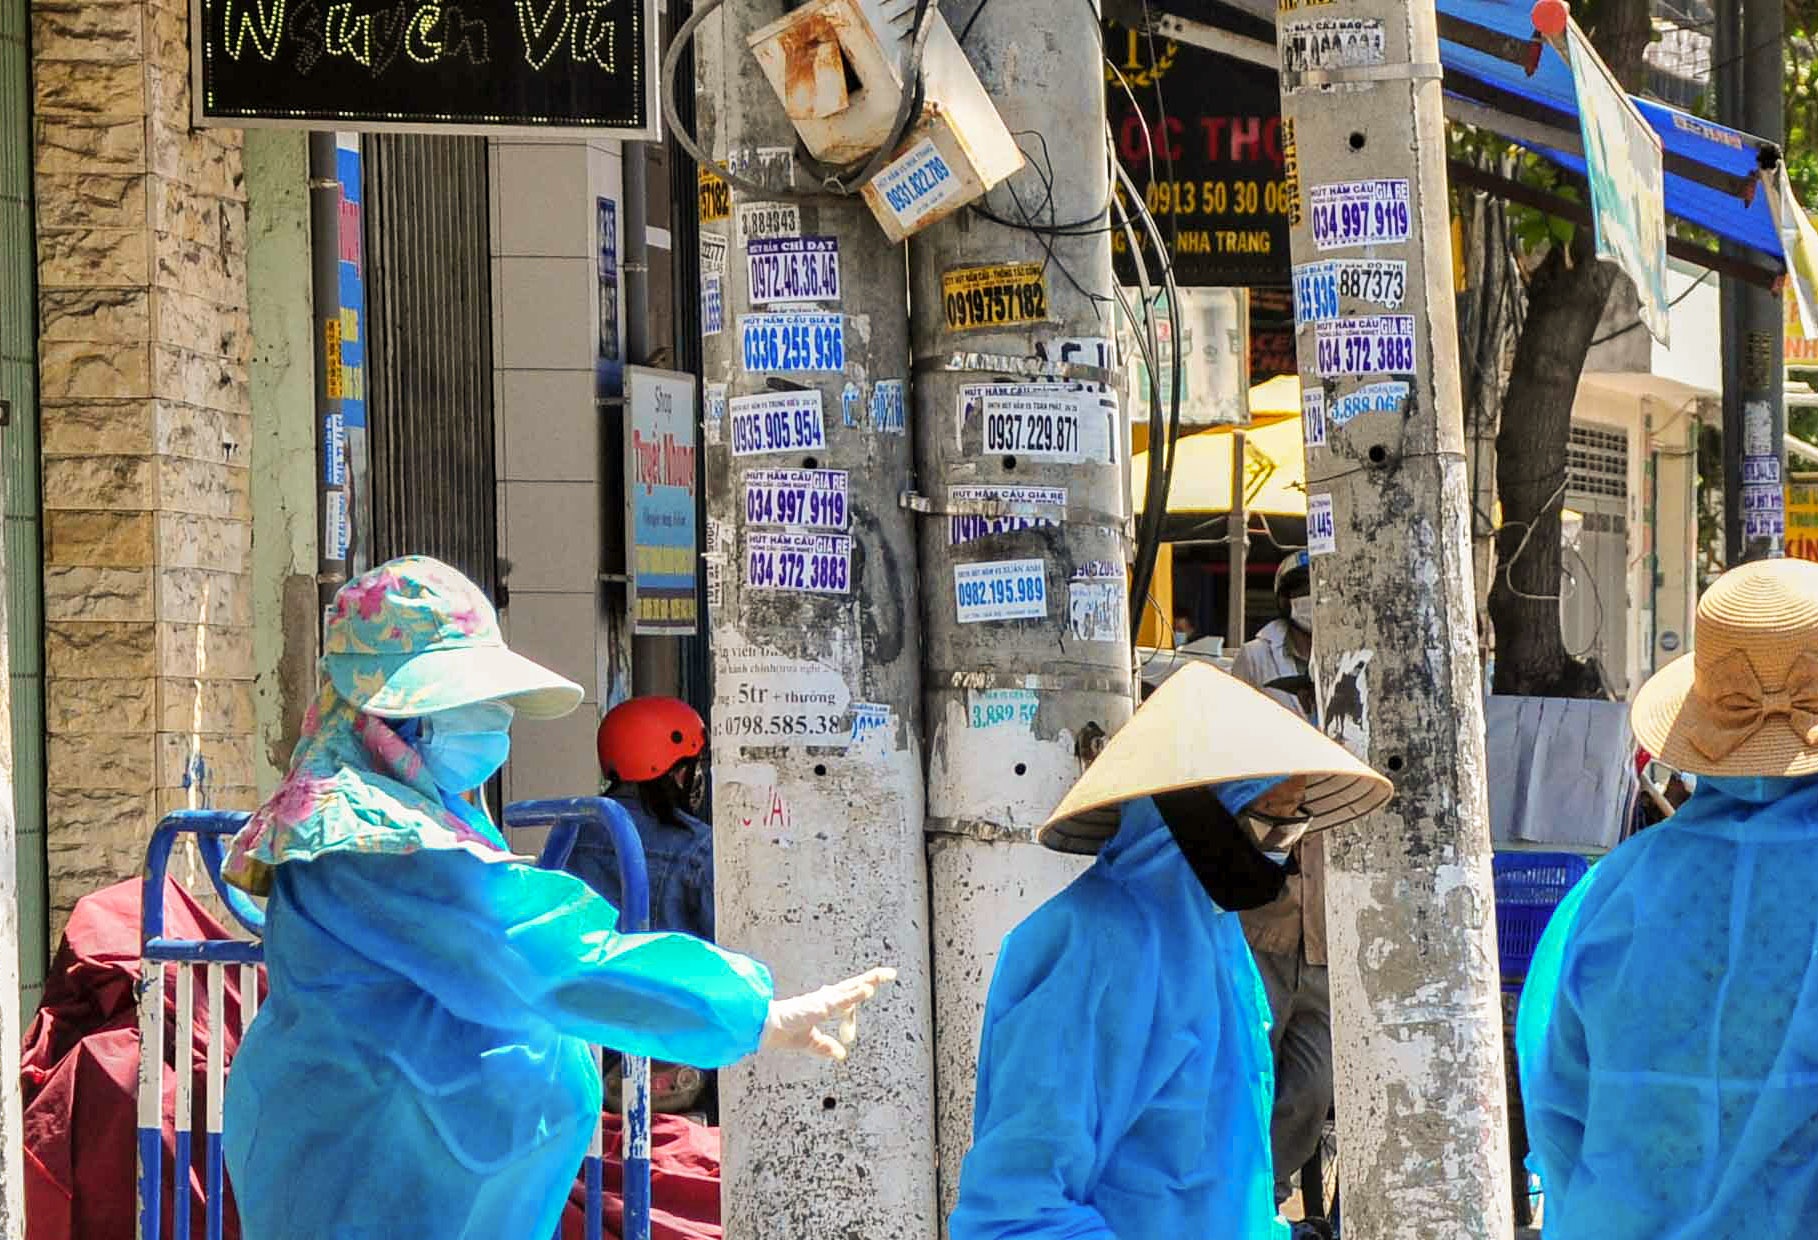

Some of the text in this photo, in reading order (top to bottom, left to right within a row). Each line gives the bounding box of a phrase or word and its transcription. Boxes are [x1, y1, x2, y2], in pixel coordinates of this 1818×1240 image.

[1202, 181, 1227, 214] 50
[1233, 181, 1259, 214] 30
[1313, 201, 1408, 240] 034.997.9119
[1176, 231, 1211, 252] NHA
[1216, 231, 1271, 253] TRANG
[752, 255, 837, 299] 0972.46.36.46
[744, 326, 842, 370] 0336.255.936
[1318, 336, 1413, 374] 034.372.3883
[733, 410, 821, 452] 0935.905.954
[988, 414, 1078, 452] 0937.229.871
[747, 489, 844, 526] 034.997.9119
[750, 552, 847, 590] 034.372.3883
[958, 575, 1043, 608] 0982.195.989
[738, 683, 769, 704] 5tr
